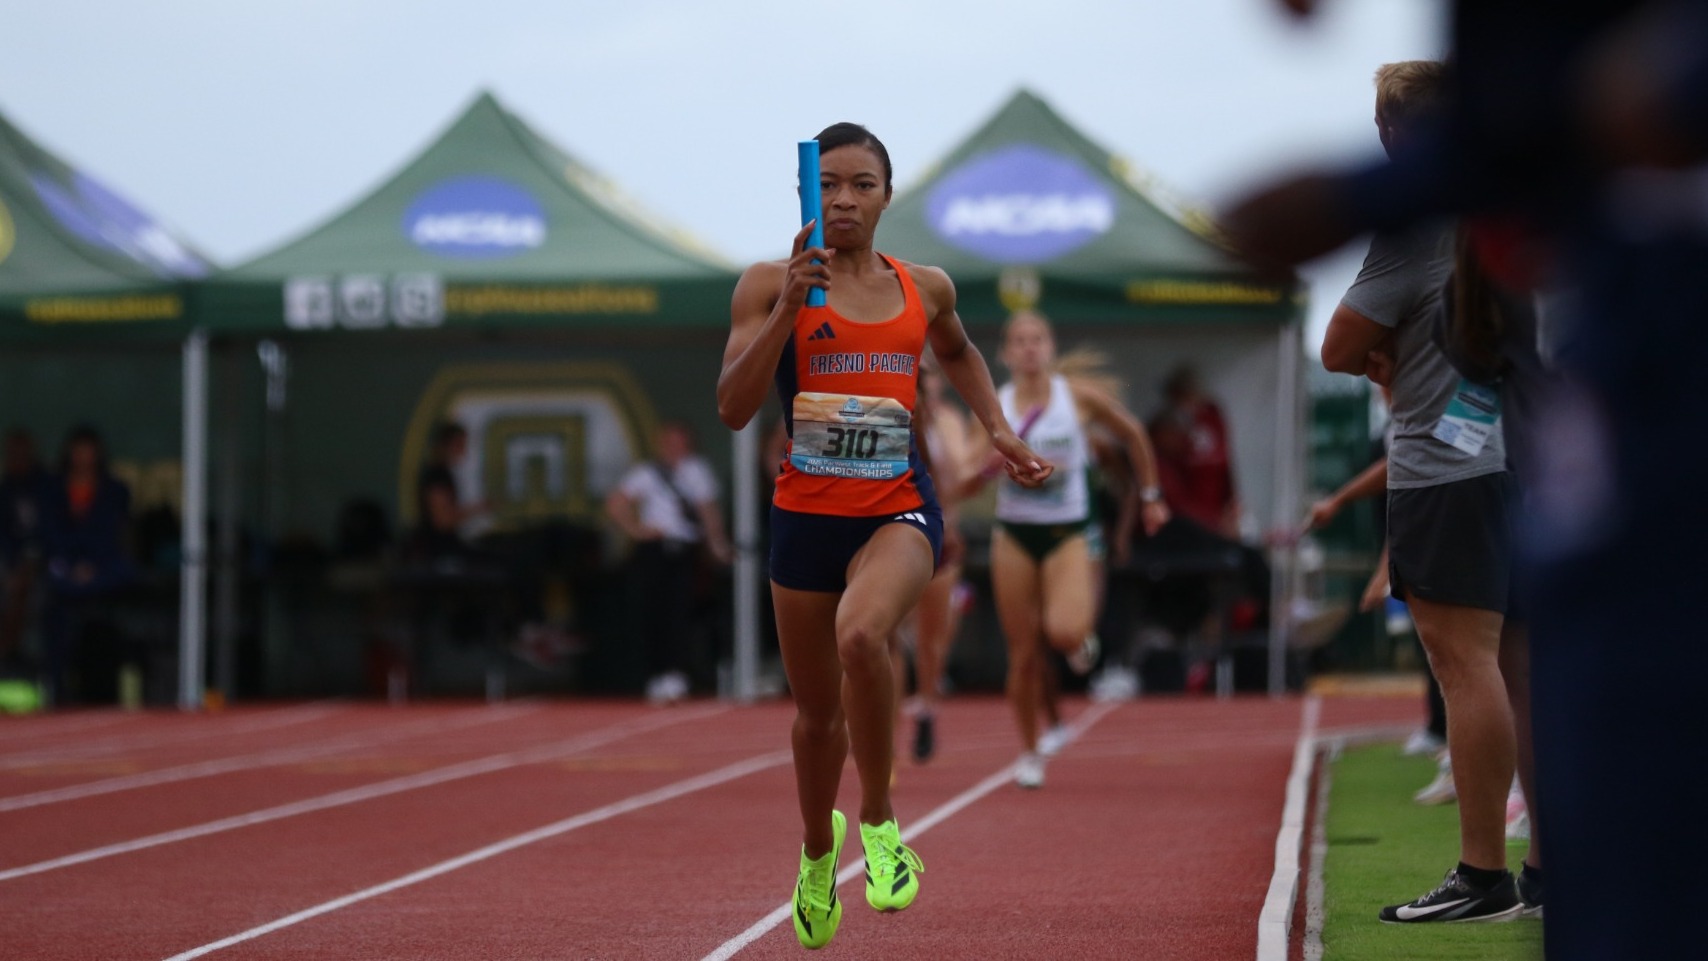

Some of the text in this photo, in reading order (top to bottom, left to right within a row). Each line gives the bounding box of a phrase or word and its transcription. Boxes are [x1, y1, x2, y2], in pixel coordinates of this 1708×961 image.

[943, 194, 1113, 235] NCAA
[810, 353, 915, 376] FRESNO PACIFIC
[822, 427, 879, 458] 310
[805, 464, 893, 478] CHAMPIONSHIPS
[877, 462, 892, 470] Field
